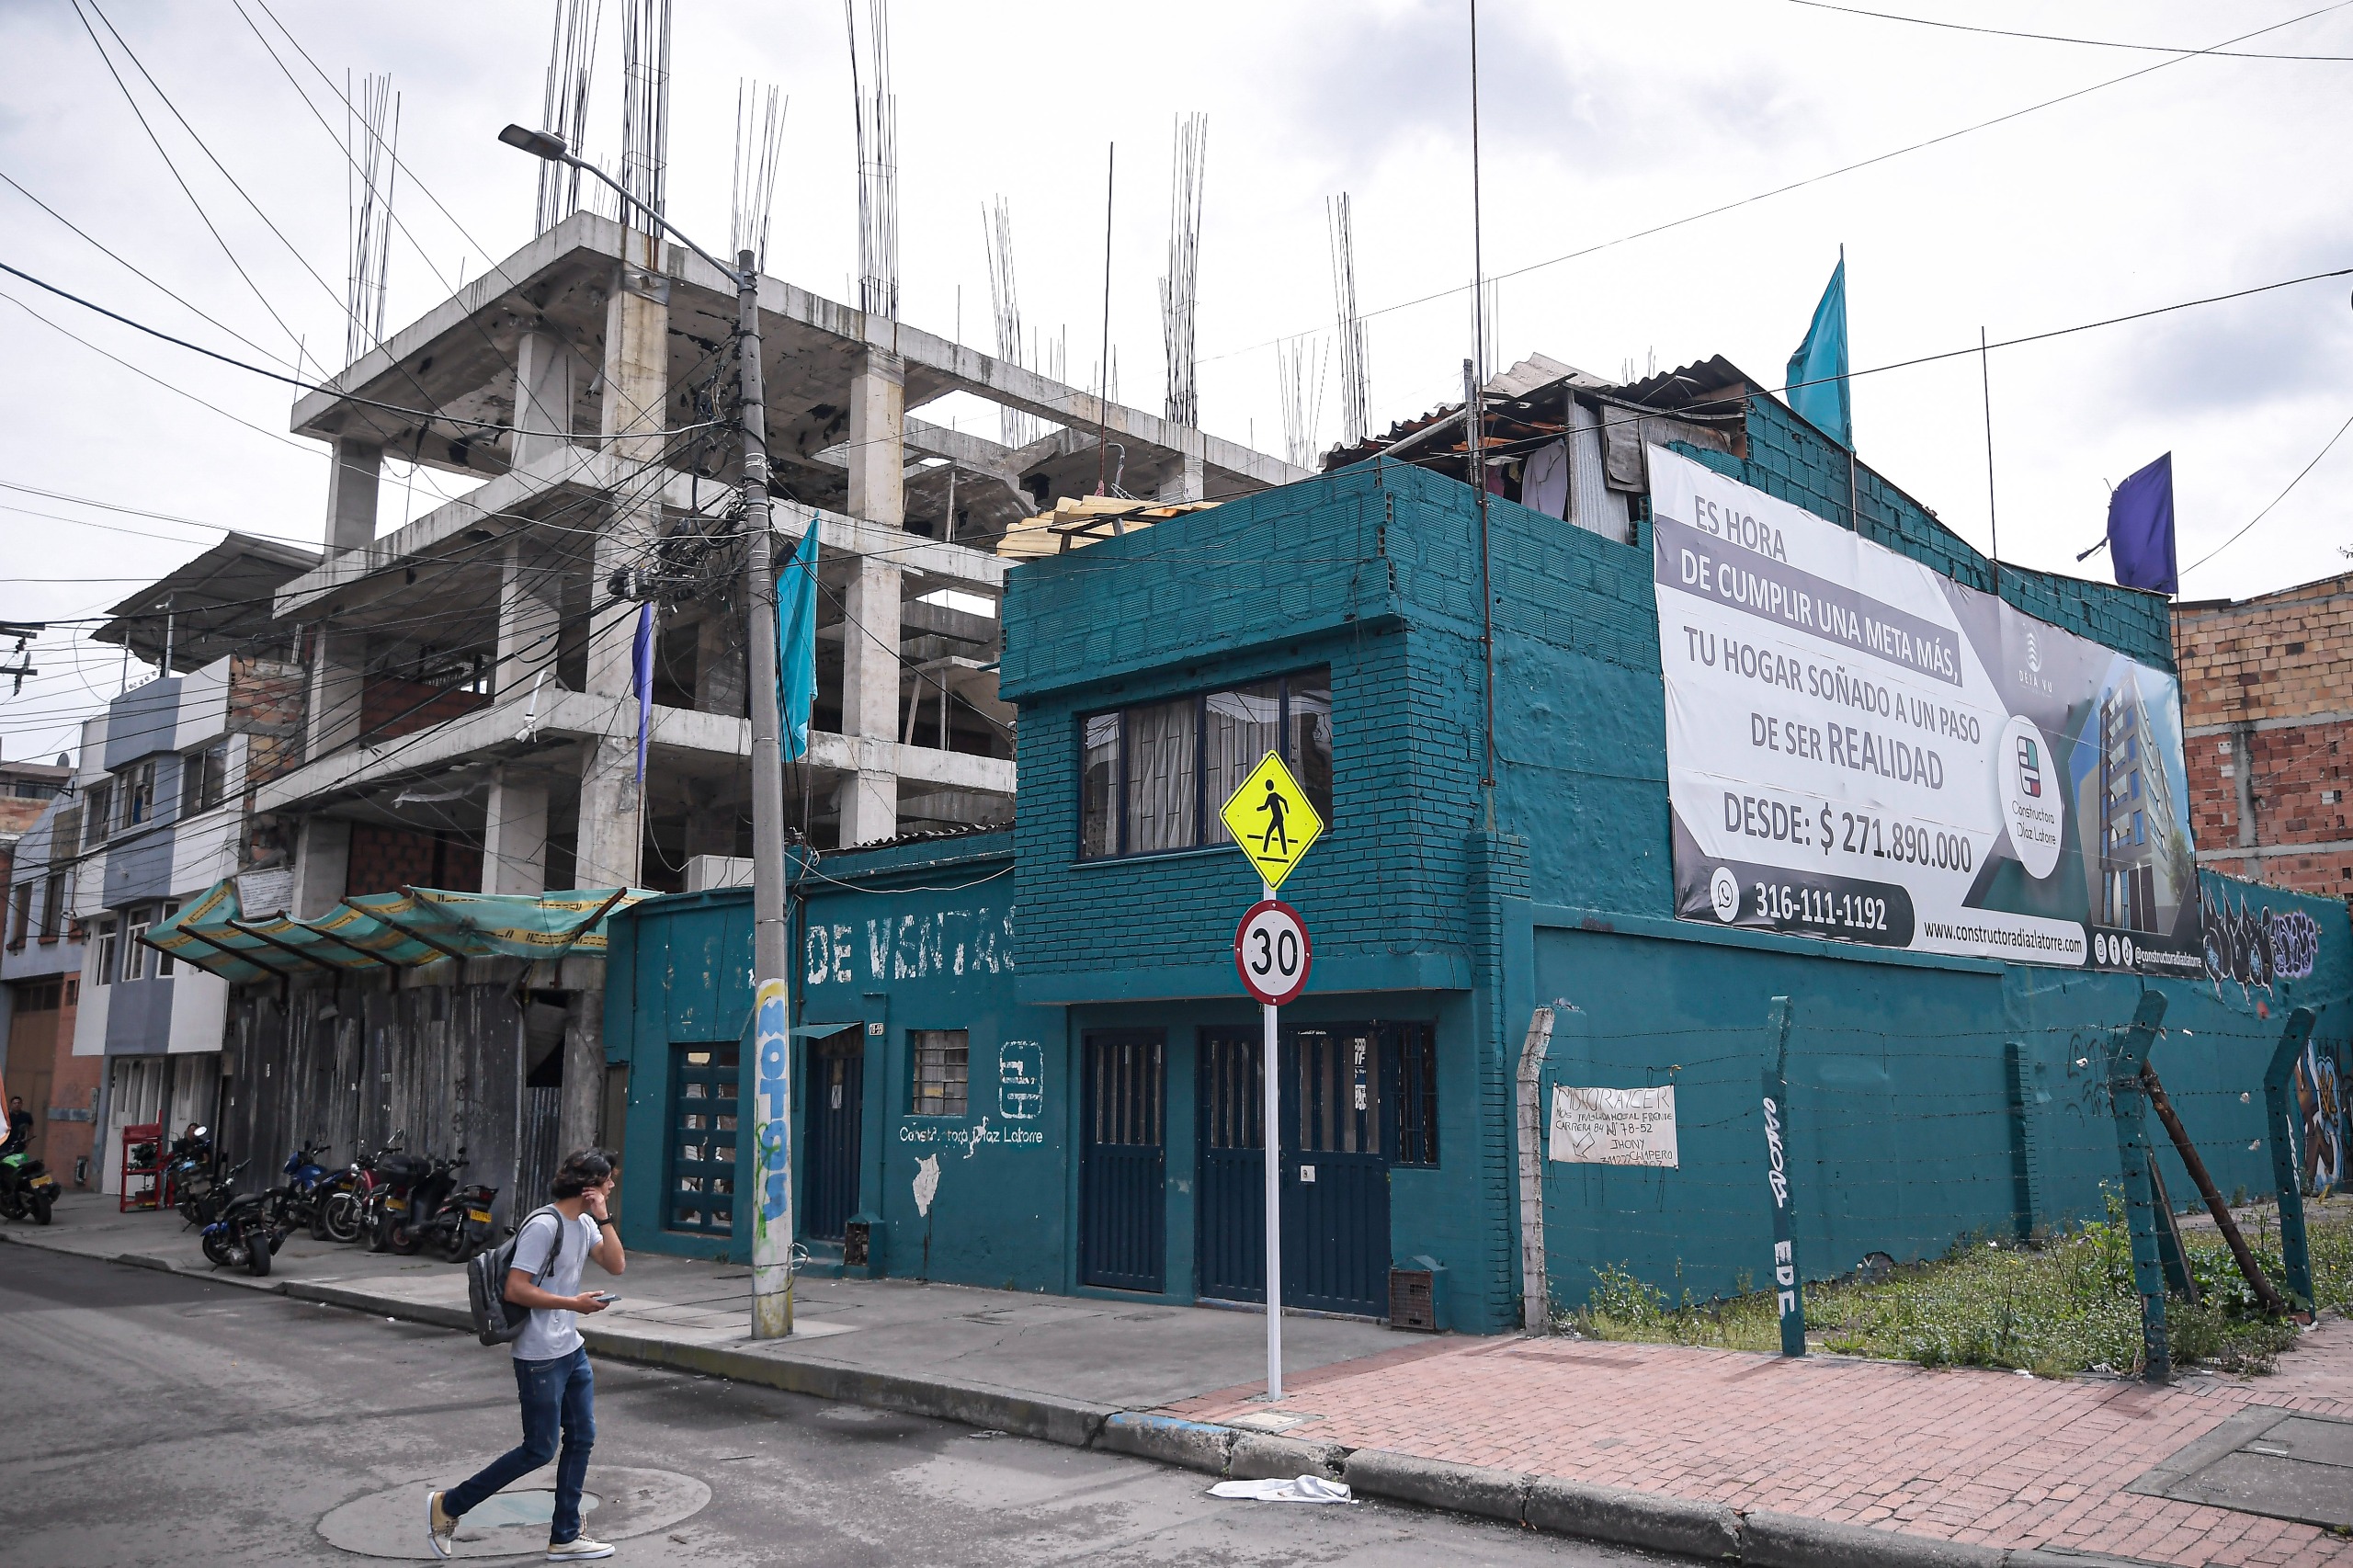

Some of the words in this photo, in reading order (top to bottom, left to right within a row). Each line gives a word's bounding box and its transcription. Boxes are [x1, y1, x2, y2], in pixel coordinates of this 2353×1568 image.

[1695, 494, 1720, 535] ES
[1725, 507, 1788, 563] HORA
[1680, 548, 1711, 592] DE
[1718, 562, 1813, 627] CUMPLIR
[1817, 598, 1862, 644] UNA
[1865, 617, 1914, 663] META
[1915, 637, 1959, 684] MÁS,
[1683, 625, 1716, 666] TU
[1723, 637, 1803, 693] HOGAR
[1808, 665, 1890, 718] SOÑADO
[1895, 692, 1908, 724] A
[1910, 697, 1936, 733] UN
[1939, 706, 1981, 745] PASO
[1751, 712, 1779, 752] DE
[1785, 722, 1823, 762] SER
[1827, 722, 1944, 790] REALIDAD
[1723, 791, 1812, 846] DESDE:
[1819, 801, 1835, 856] $
[1841, 812, 1972, 873] 271.890.000
[2011, 800, 2055, 824] Constructora
[2033, 826, 2056, 846] Latorre
[1755, 881, 1888, 931] 316-111-1192
[806, 923, 853, 985] DE
[1251, 927, 1299, 977] 30
[1924, 921, 2083, 954] www.constructoradiazlatorre.com
[757, 998, 788, 1223] MOTOS
[1004, 1126, 1044, 1143] Latorre
[1555, 1120, 1591, 1131] CARRERA
[1620, 1122, 1654, 1137] 78-52
